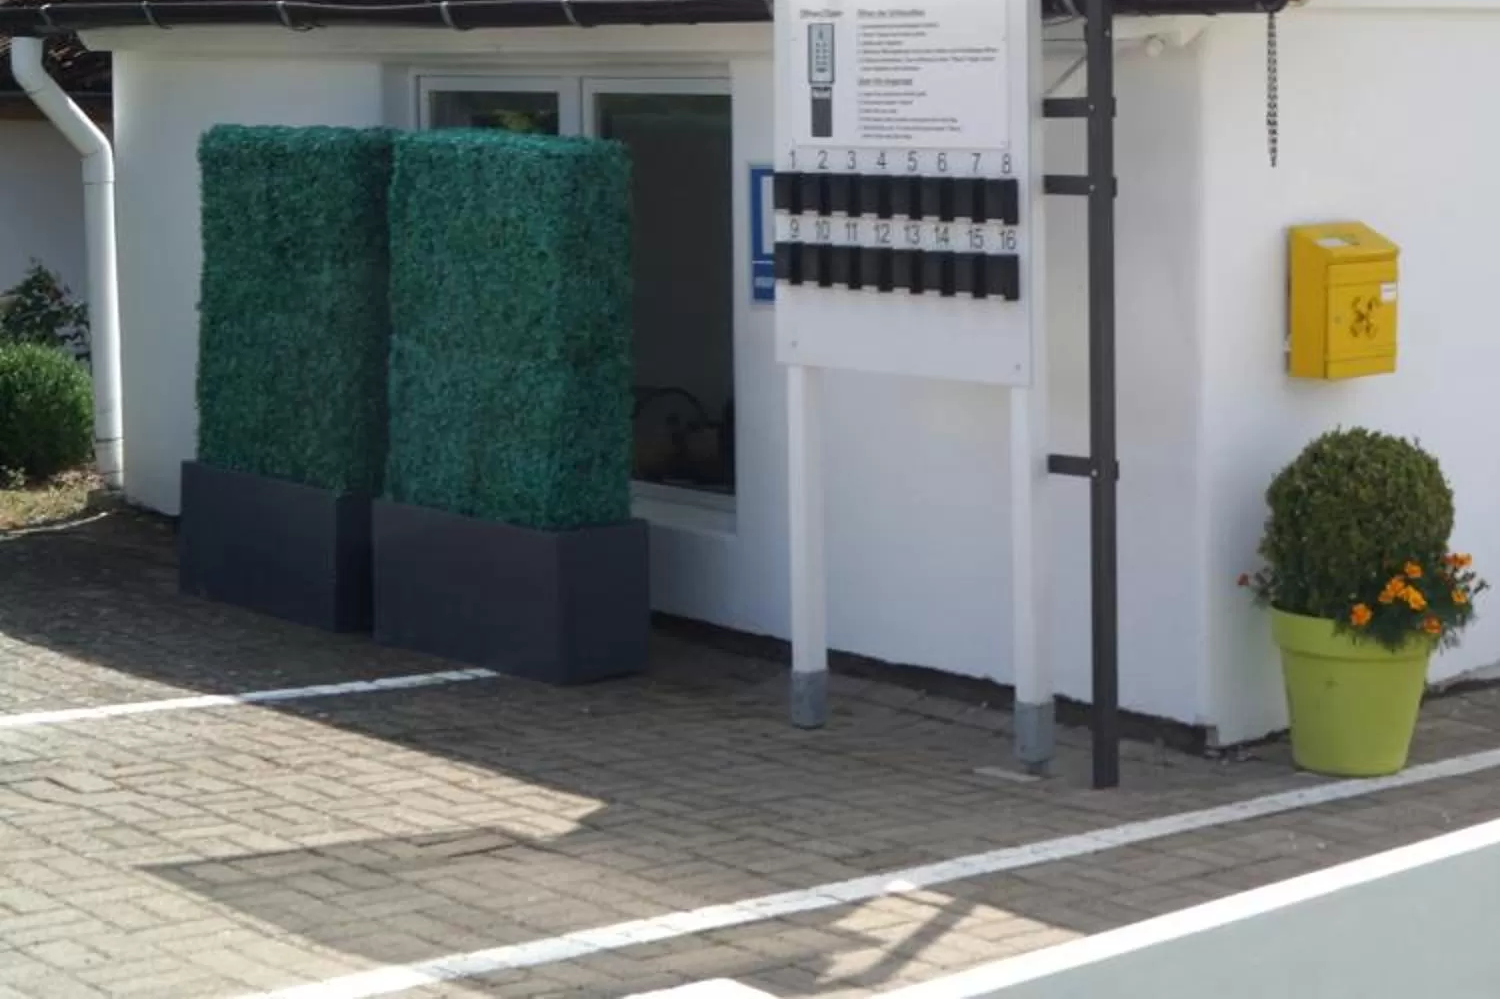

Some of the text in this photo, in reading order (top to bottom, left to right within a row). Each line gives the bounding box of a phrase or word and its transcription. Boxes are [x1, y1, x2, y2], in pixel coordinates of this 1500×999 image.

[789, 150, 1012, 174] 1 2 3 4 5 6 7 8
[789, 219, 1016, 250] 9 10 11 12 13 14 15 16
